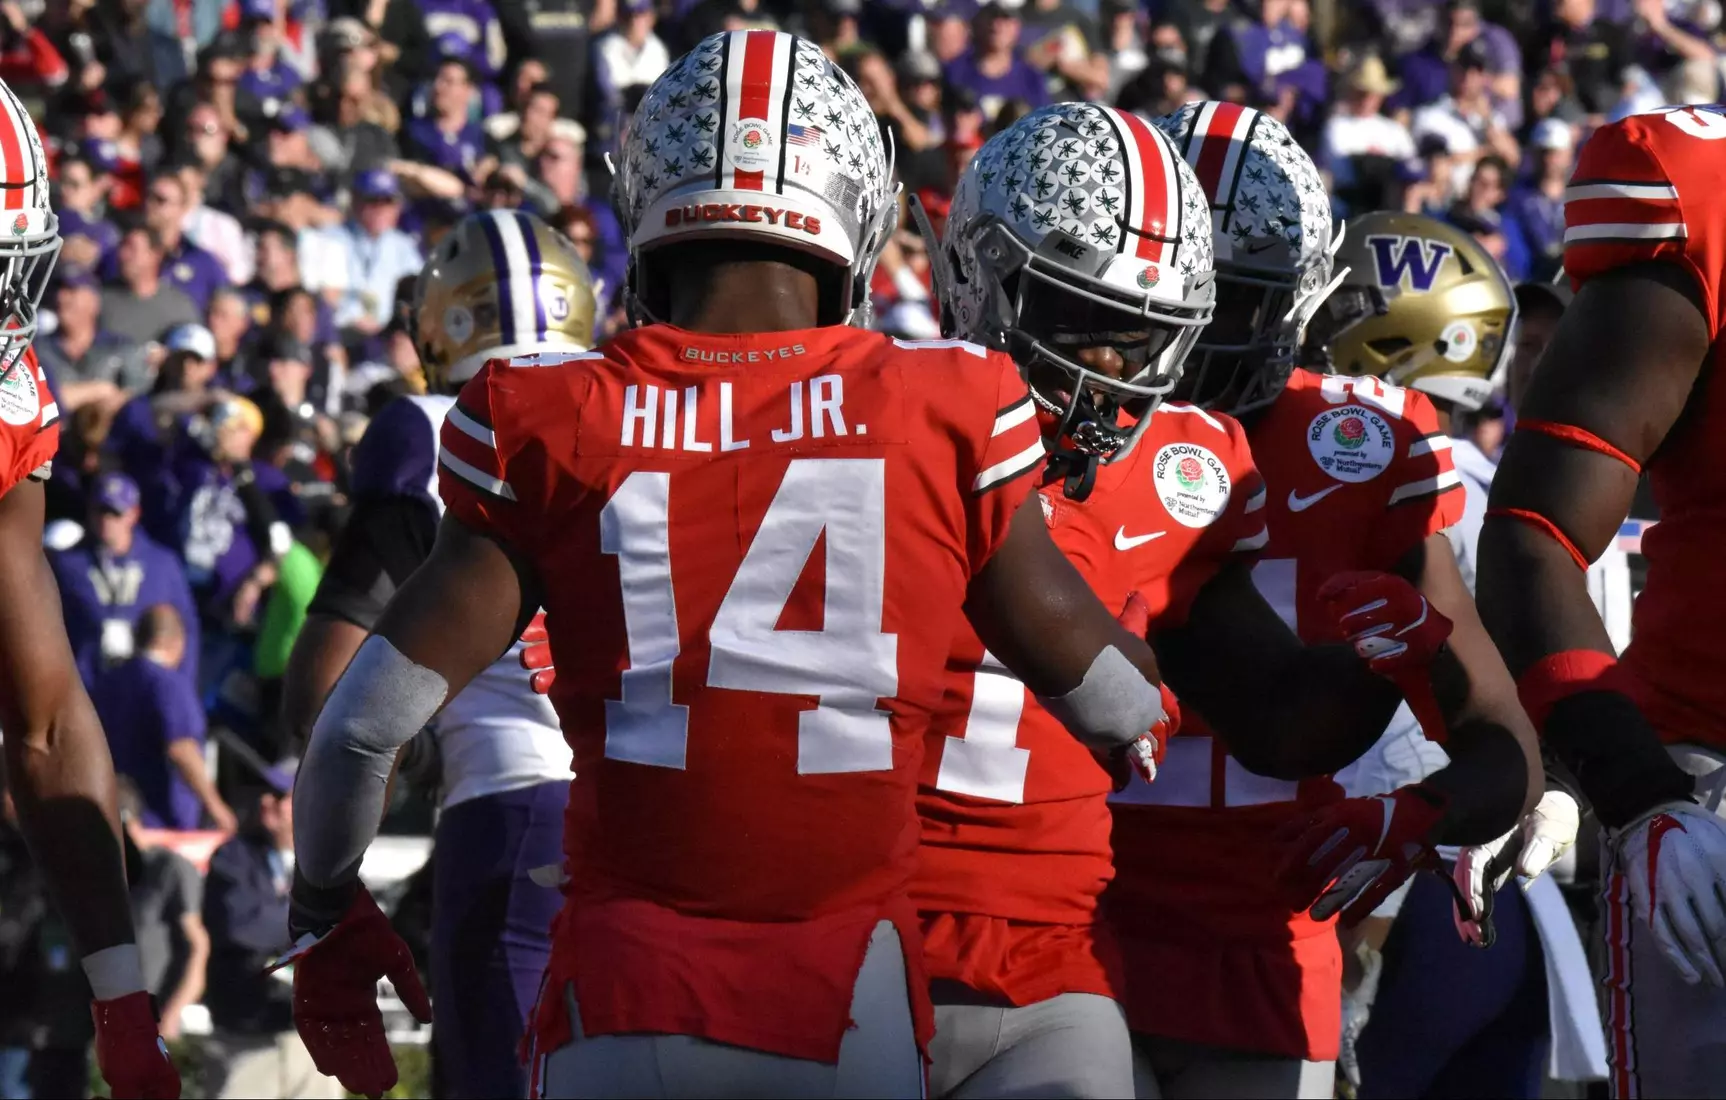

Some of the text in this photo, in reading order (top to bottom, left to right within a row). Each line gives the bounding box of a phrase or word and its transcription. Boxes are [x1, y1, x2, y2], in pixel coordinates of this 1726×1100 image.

[732, 126, 744, 144] ROSE
[744, 122, 763, 130] BOWL
[665, 203, 822, 236] BUCKEYES
[1054, 238, 1087, 260] NIKE
[1365, 234, 1453, 293] W
[685, 344, 806, 363] BUCKEYES
[621, 374, 867, 452] HILL JR.
[1312, 407, 1392, 449] ROSE BOWL GAME
[1157, 446, 1228, 494] ROSE BOWL GAME
[600, 458, 899, 774] 14
